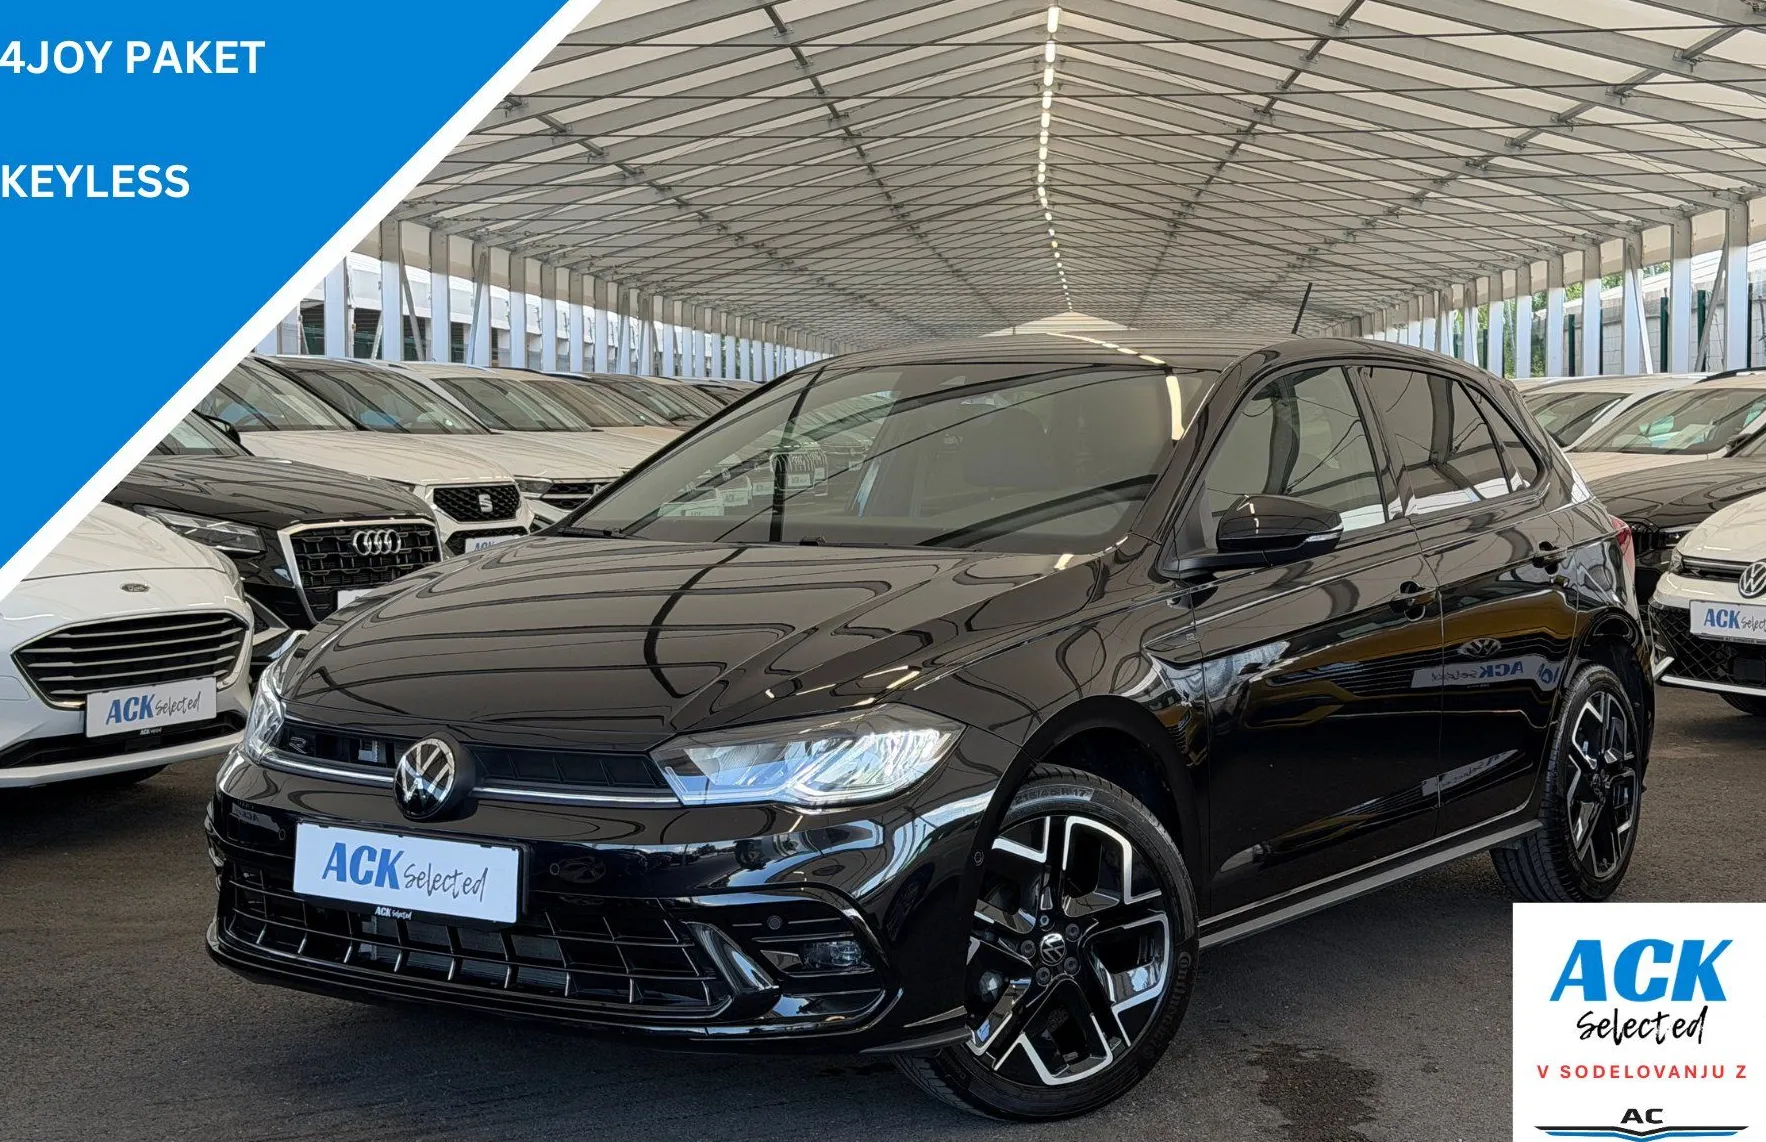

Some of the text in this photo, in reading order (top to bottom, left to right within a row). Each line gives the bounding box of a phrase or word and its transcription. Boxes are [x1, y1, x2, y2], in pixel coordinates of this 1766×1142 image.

[1703, 608, 1741, 630] ACK
[105, 691, 201, 725] ACK Selected
[321, 842, 489, 902] ACK Selected
[374, 906, 391, 917] ACK
